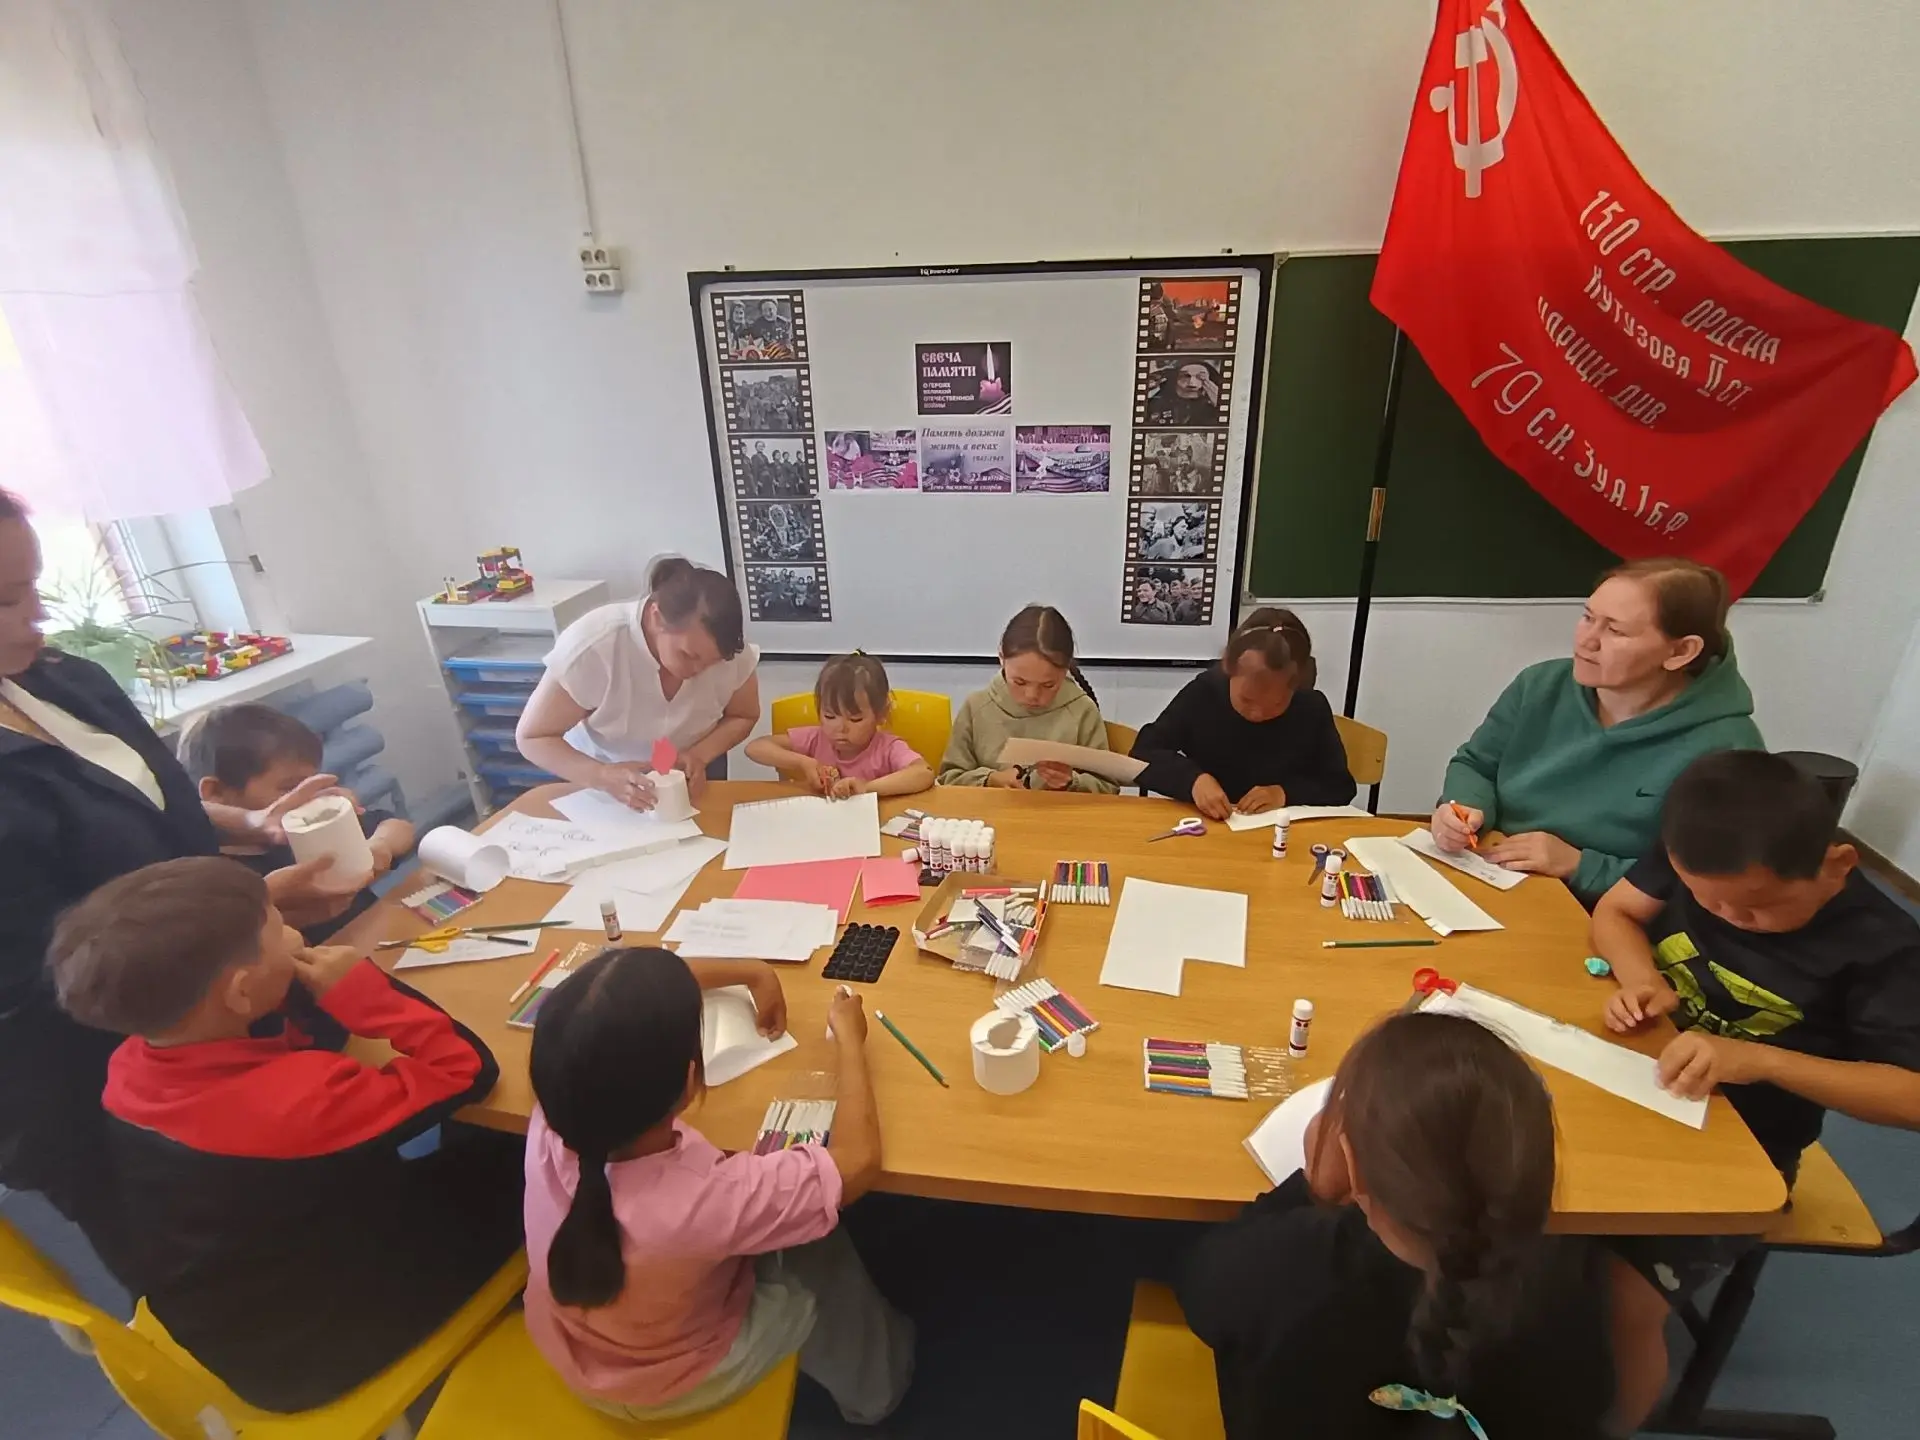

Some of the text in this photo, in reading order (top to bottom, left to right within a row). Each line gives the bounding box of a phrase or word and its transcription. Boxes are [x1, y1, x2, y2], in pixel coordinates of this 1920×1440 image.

[1580, 190, 1781, 365] 150 СТР. ОРДЕНА
[1583, 265, 1691, 380] КУТУЗОВА
[921, 351, 962, 363] СВЕЧА
[922, 366, 977, 377] ПАМЯТИ
[1471, 342, 1544, 416] 79
[923, 394, 975, 402] ОТЕЧЕСТВЕННОЙ
[1607, 384, 1667, 429] ДИВ.
[921, 427, 1005, 438] Память должна
[930, 443, 960, 451] жить
[971, 443, 998, 451] веках
